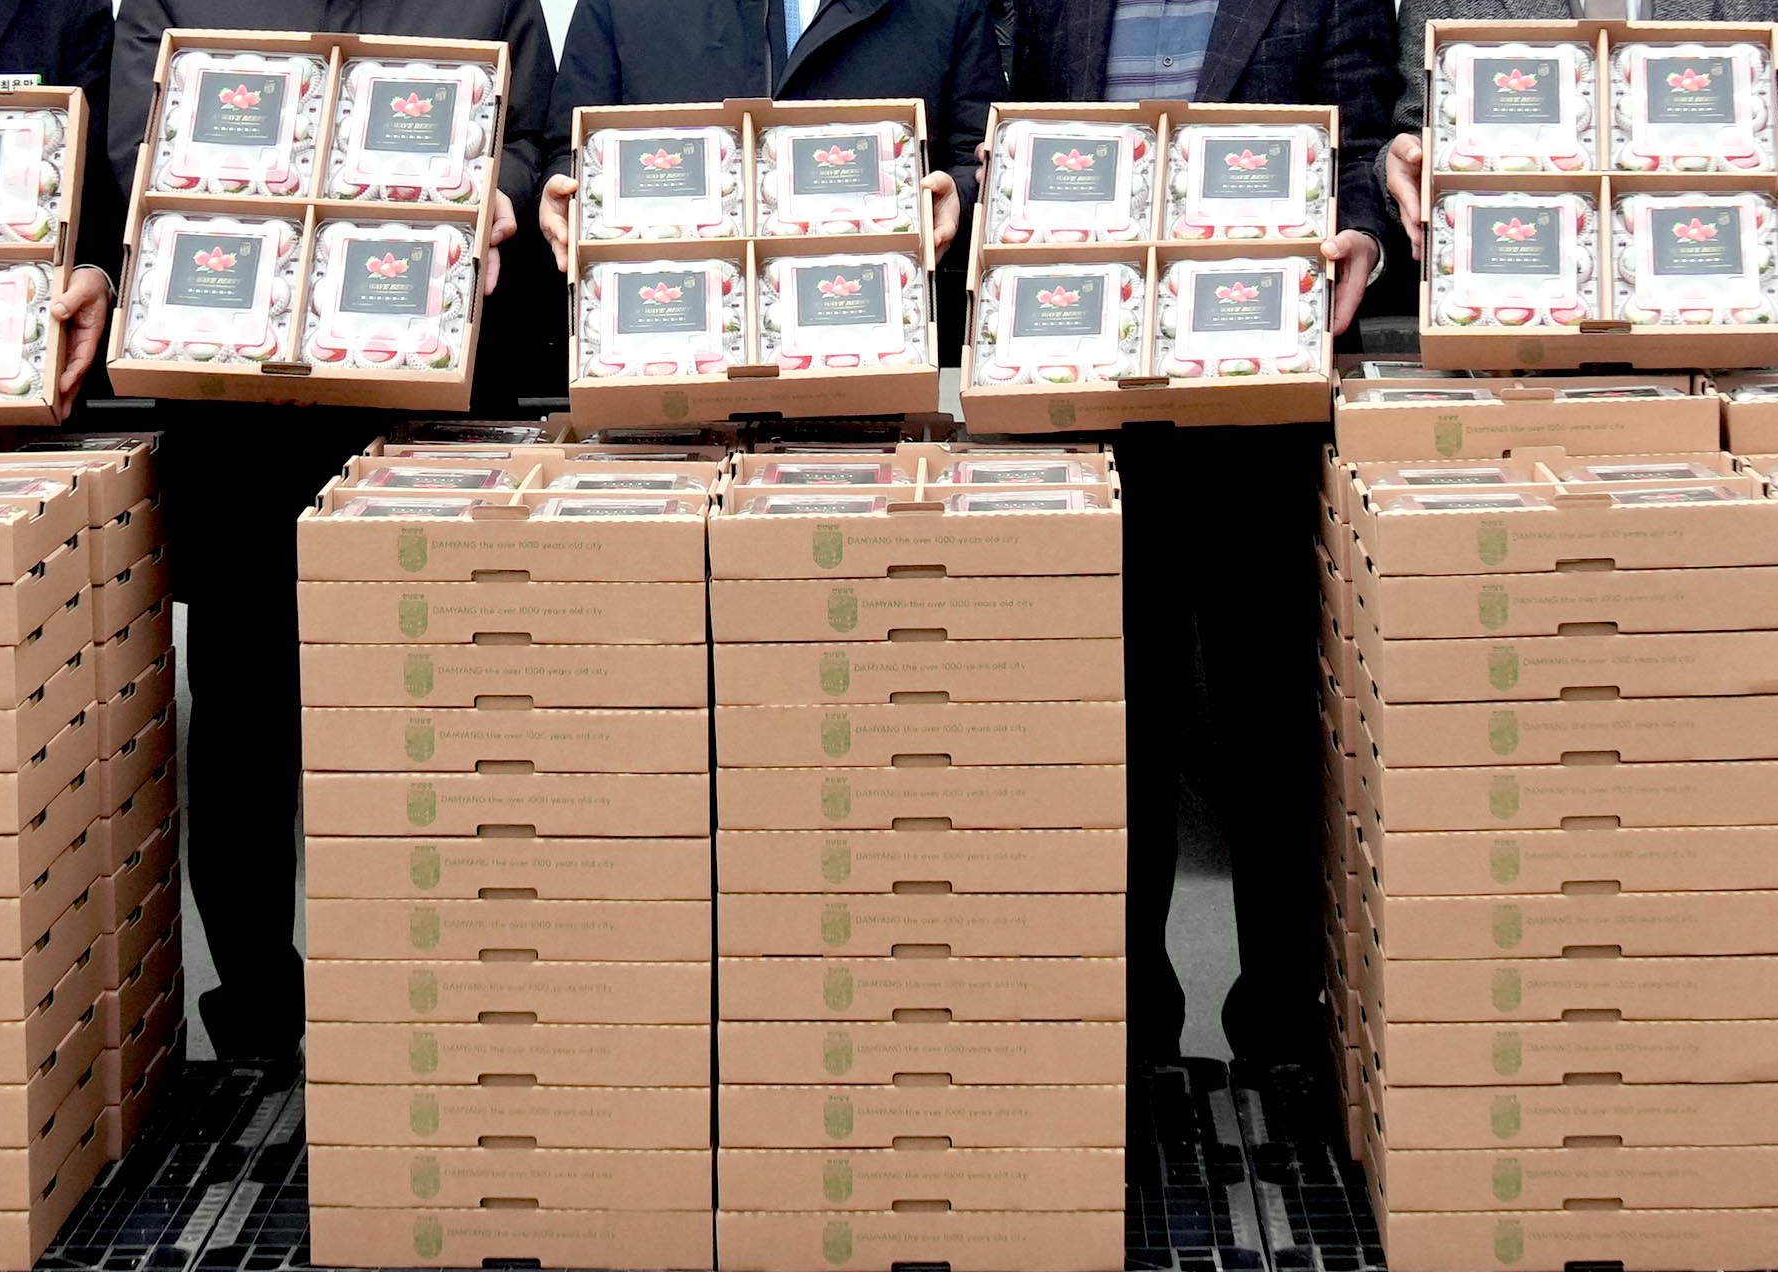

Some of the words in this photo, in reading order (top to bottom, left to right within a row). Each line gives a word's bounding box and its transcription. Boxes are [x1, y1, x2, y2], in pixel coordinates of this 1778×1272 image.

[430, 540, 476, 550] DAMYANG
[479, 540, 495, 550] the
[496, 542, 516, 550] over
[518, 540, 540, 550] 1000
[541, 542, 566, 551] years
[568, 540, 583, 550] old
[584, 540, 603, 551] city
[846, 536, 893, 546] DAMYANG
[895, 536, 911, 545] the
[913, 537, 933, 545] over
[934, 536, 957, 545] 1000
[958, 537, 983, 547] years
[985, 535, 1000, 545] old
[1001, 535, 1020, 546] city
[862, 600, 908, 610] DAMYANG
[910, 600, 926, 609] the
[928, 601, 948, 609] over
[949, 600, 972, 609] 1000
[973, 601, 998, 611] years
[1000, 599, 1015, 609] old
[1016, 599, 1035, 610] city
[430, 606, 476, 616] DAMYANG
[479, 606, 495, 616] the
[496, 608, 516, 616] over
[518, 606, 540, 616] 1000
[541, 608, 566, 617] years
[568, 606, 583, 616] old
[584, 606, 603, 617] city
[436, 666, 482, 676] DAMYANG
